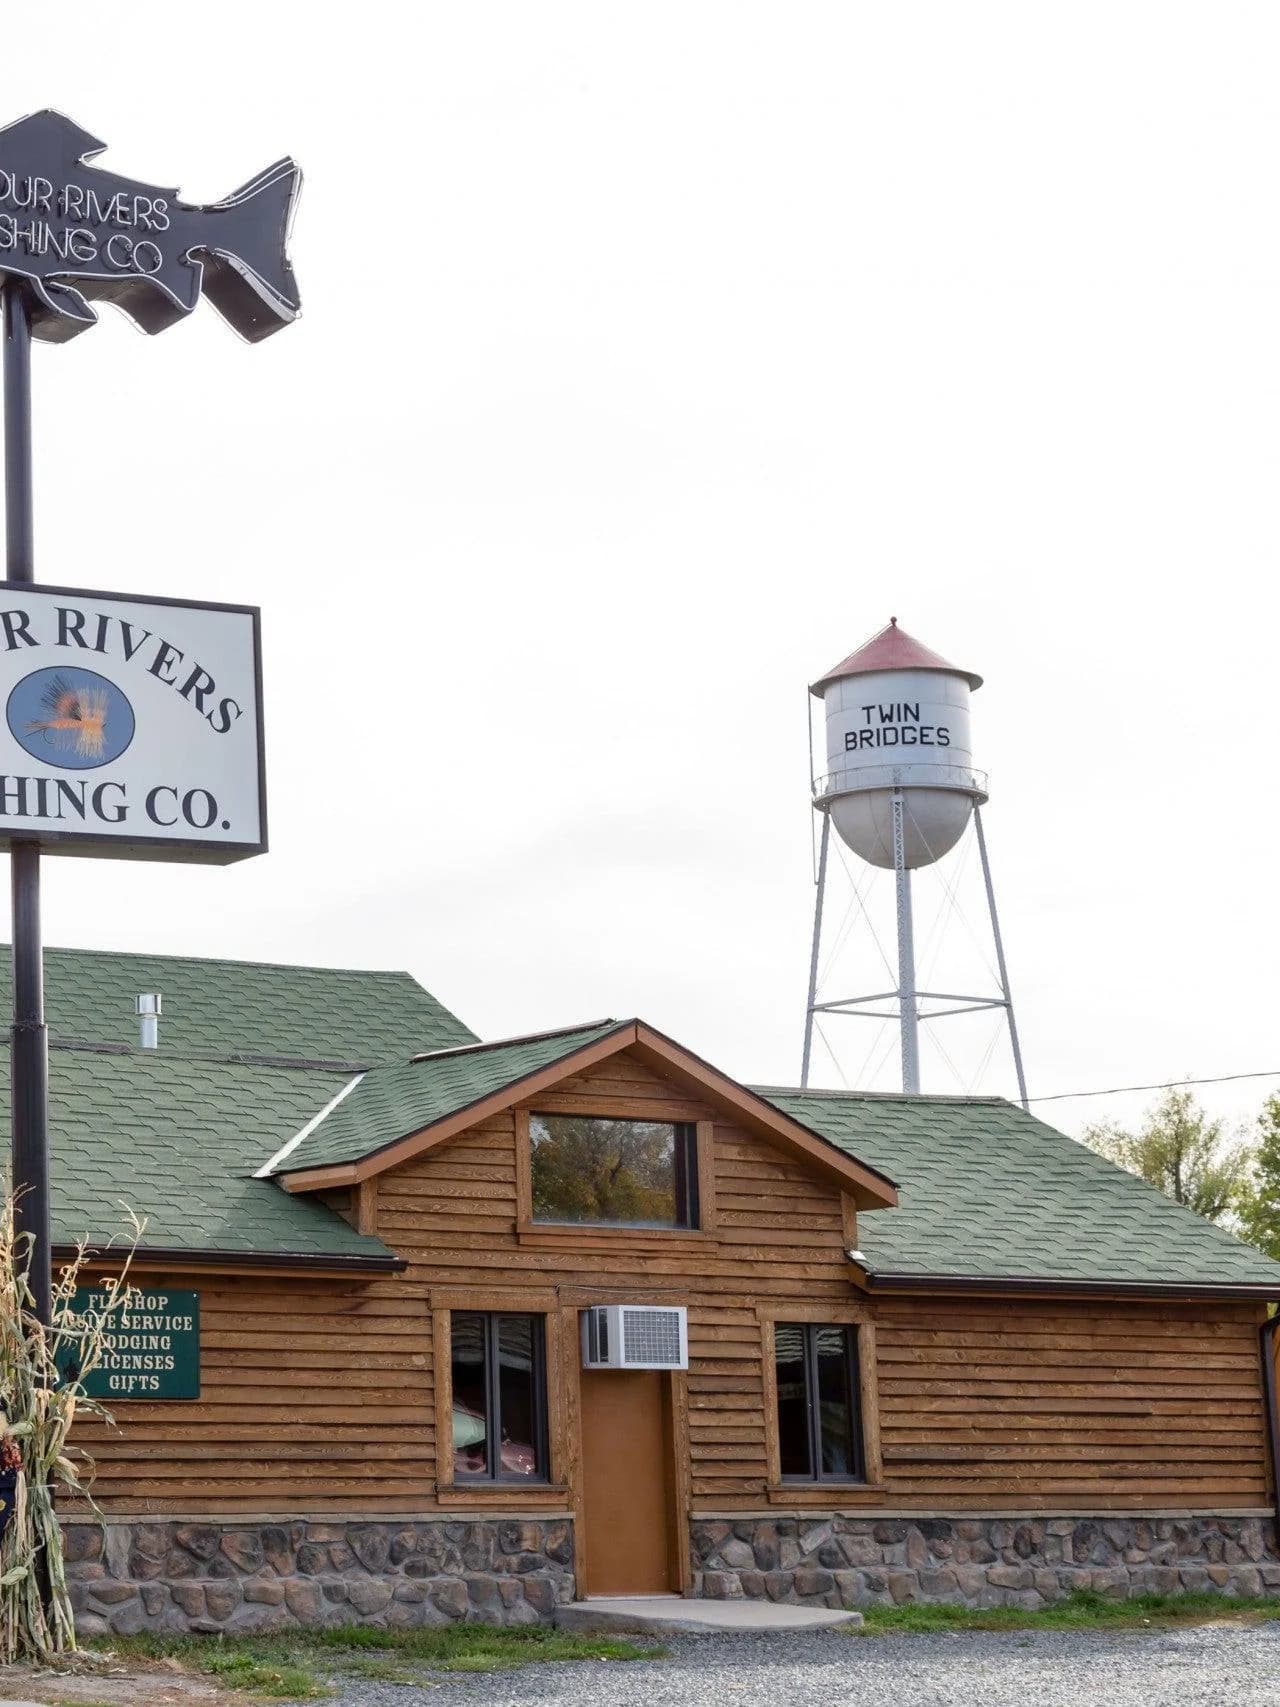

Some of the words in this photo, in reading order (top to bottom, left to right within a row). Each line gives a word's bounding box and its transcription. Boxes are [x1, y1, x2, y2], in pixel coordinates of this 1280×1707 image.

[63, 181, 171, 230] RIVERS
[107, 234, 163, 275] CO
[53, 606, 244, 736] RIVERS
[861, 702, 920, 725] TWIN
[844, 726, 951, 751] BRIDGES
[144, 785, 232, 832] CO.
[88, 1294, 119, 1309] FL
[126, 1296, 169, 1310] SHOP
[120, 1315, 193, 1331] SERVICE
[109, 1375, 160, 1390] GIFTS
